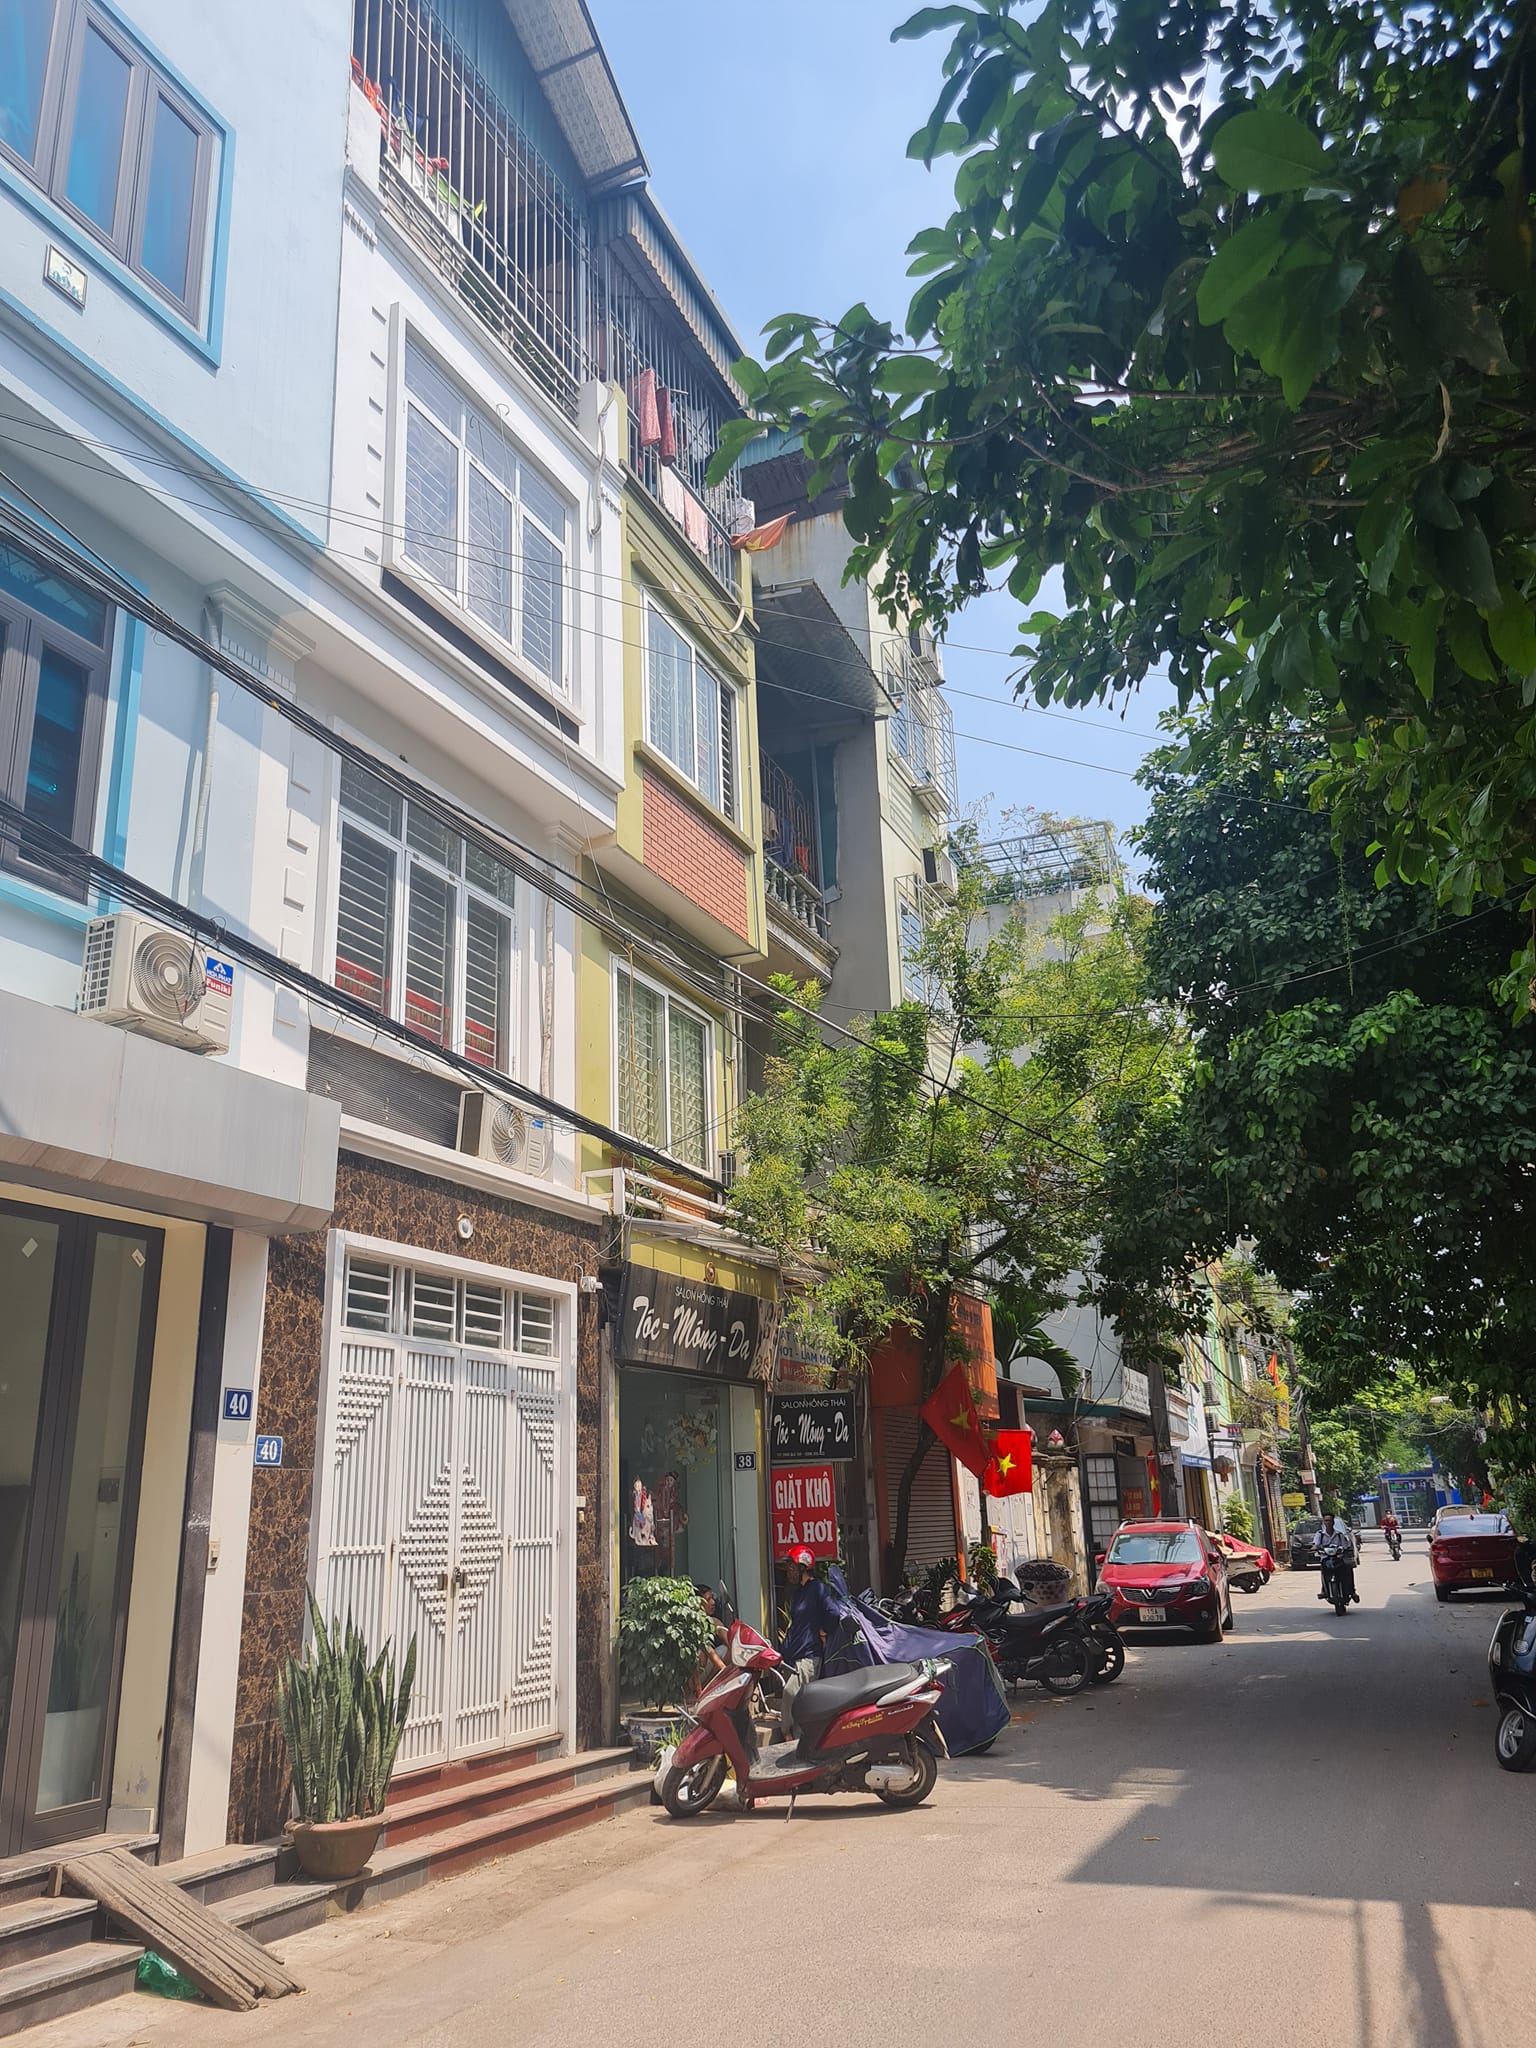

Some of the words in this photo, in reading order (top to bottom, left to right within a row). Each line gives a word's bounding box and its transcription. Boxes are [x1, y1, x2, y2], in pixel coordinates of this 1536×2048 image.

[674, 1286, 697, 1301] SALON
[632, 1295, 660, 1341] Tóc
[673, 1304, 718, 1364] Móng
[728, 1320, 750, 1361] Da
[229, 1393, 248, 1415] 40
[781, 1400, 805, 1409] SALON
[798, 1413, 825, 1454] Móng
[834, 1411, 849, 1443] Da
[260, 1440, 278, 1461] 40
[738, 1455, 752, 1468] 38
[775, 1473, 802, 1515] GIẶT
[805, 1471, 831, 1508] KHÔ
[802, 1518, 833, 1543] HƠI
